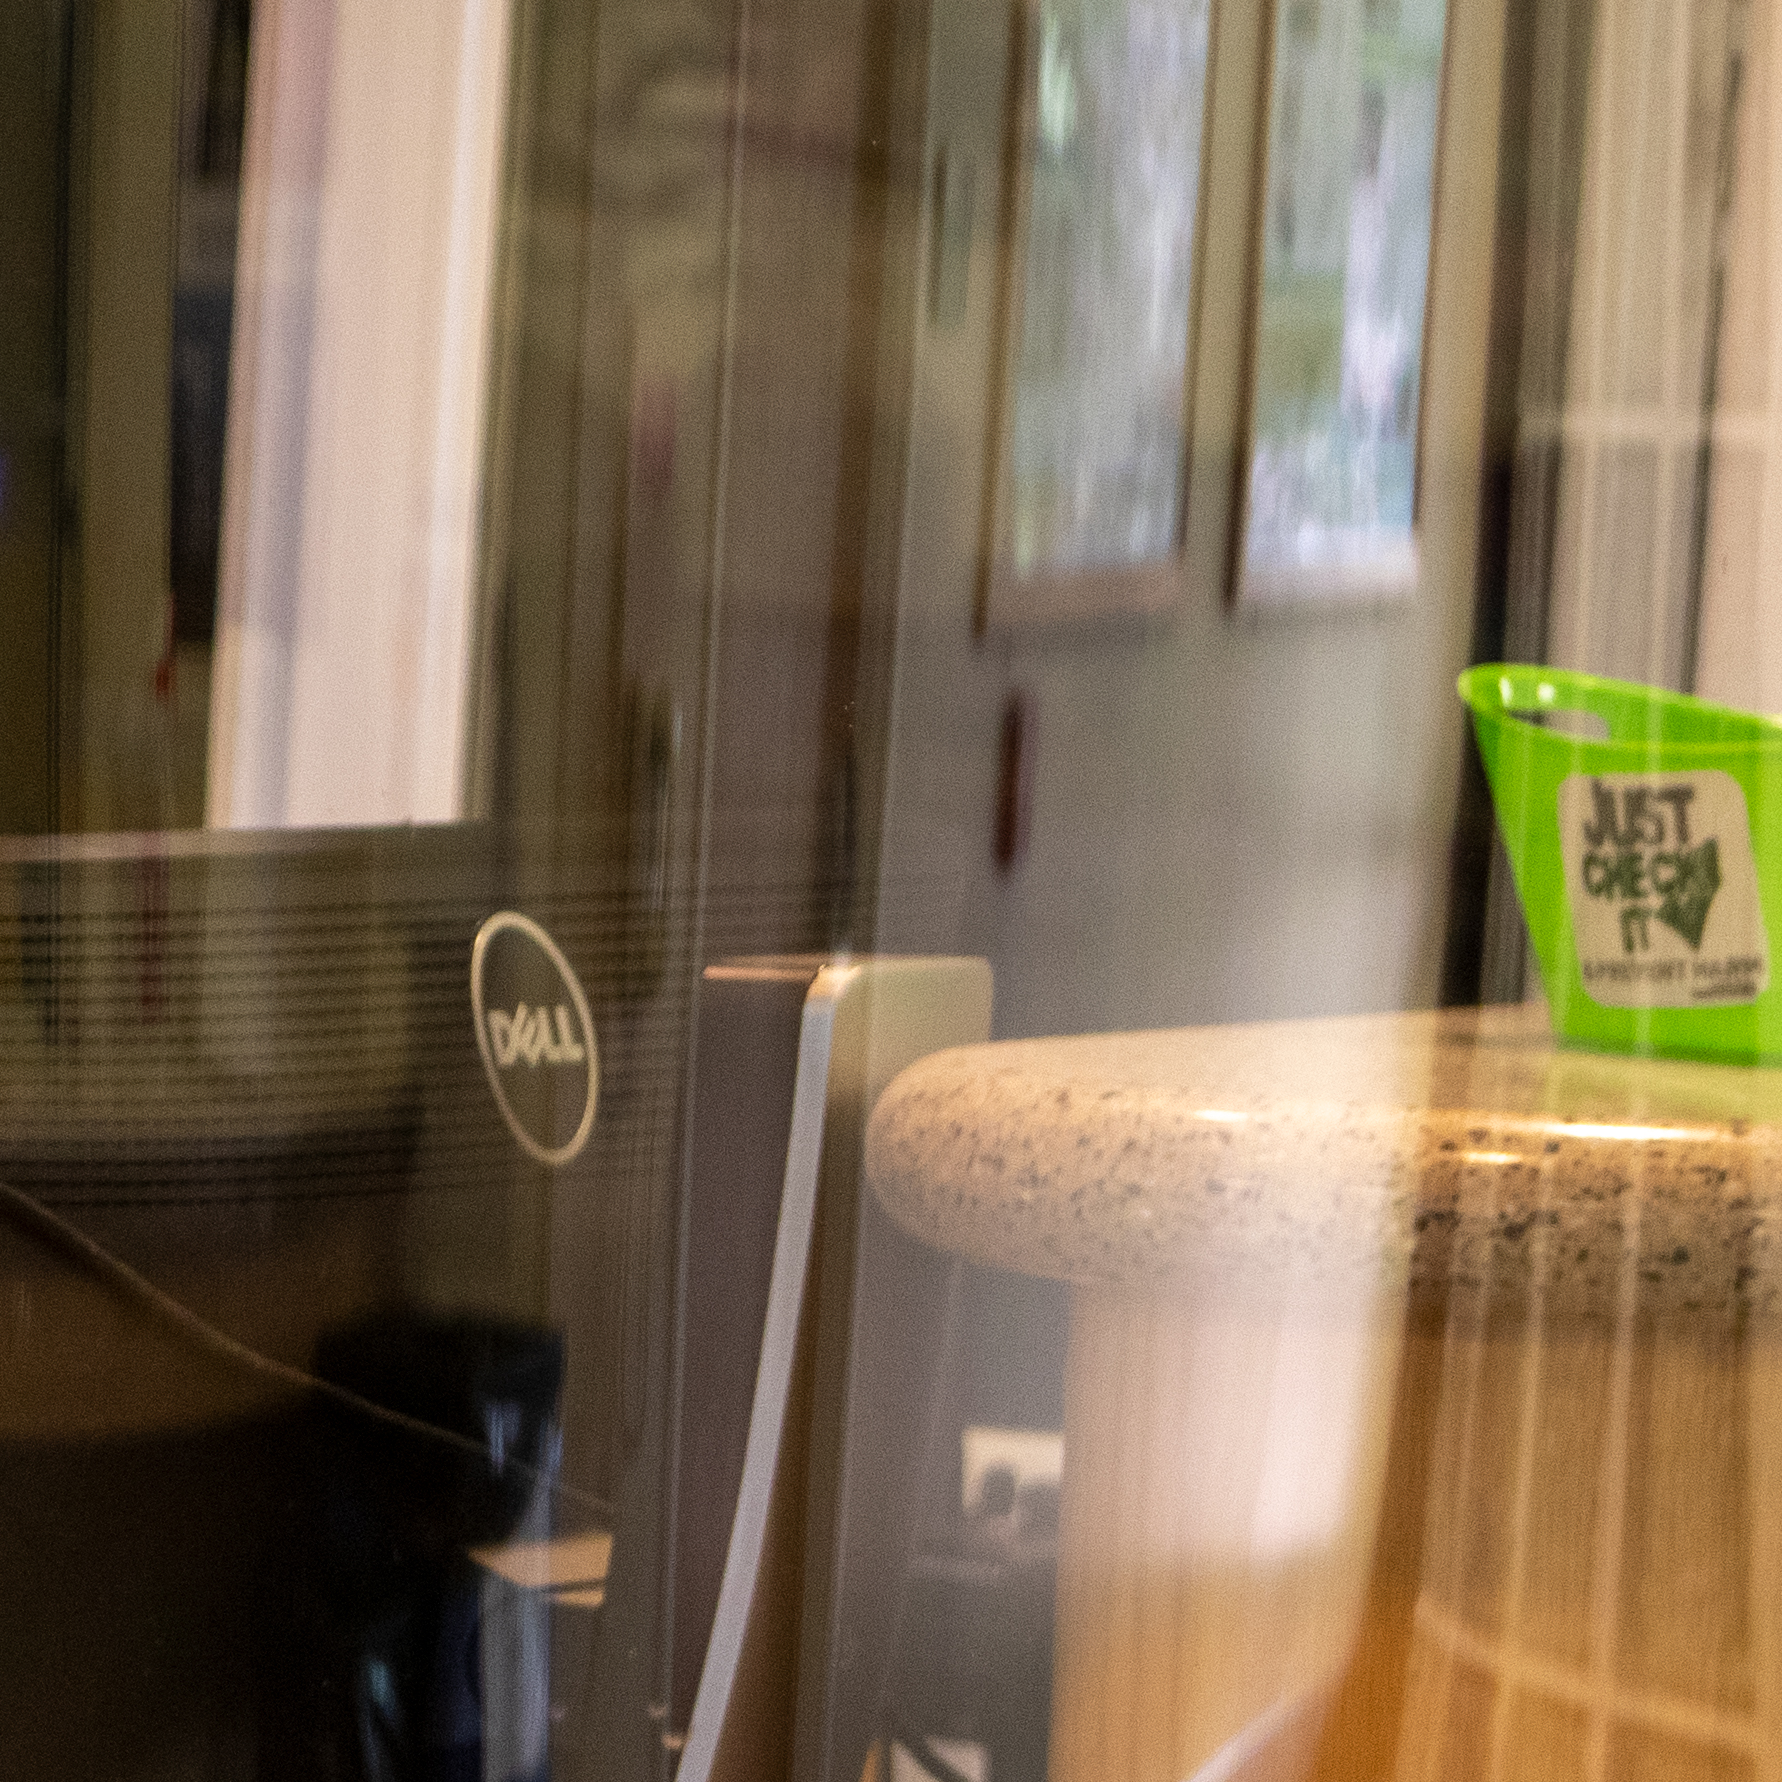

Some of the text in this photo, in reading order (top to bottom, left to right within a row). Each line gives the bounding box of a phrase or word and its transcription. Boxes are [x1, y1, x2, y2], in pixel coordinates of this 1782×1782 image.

[1583, 776, 1695, 847] JUST
[1619, 905, 1651, 953] IT
[487, 1002, 585, 1066] DELL
